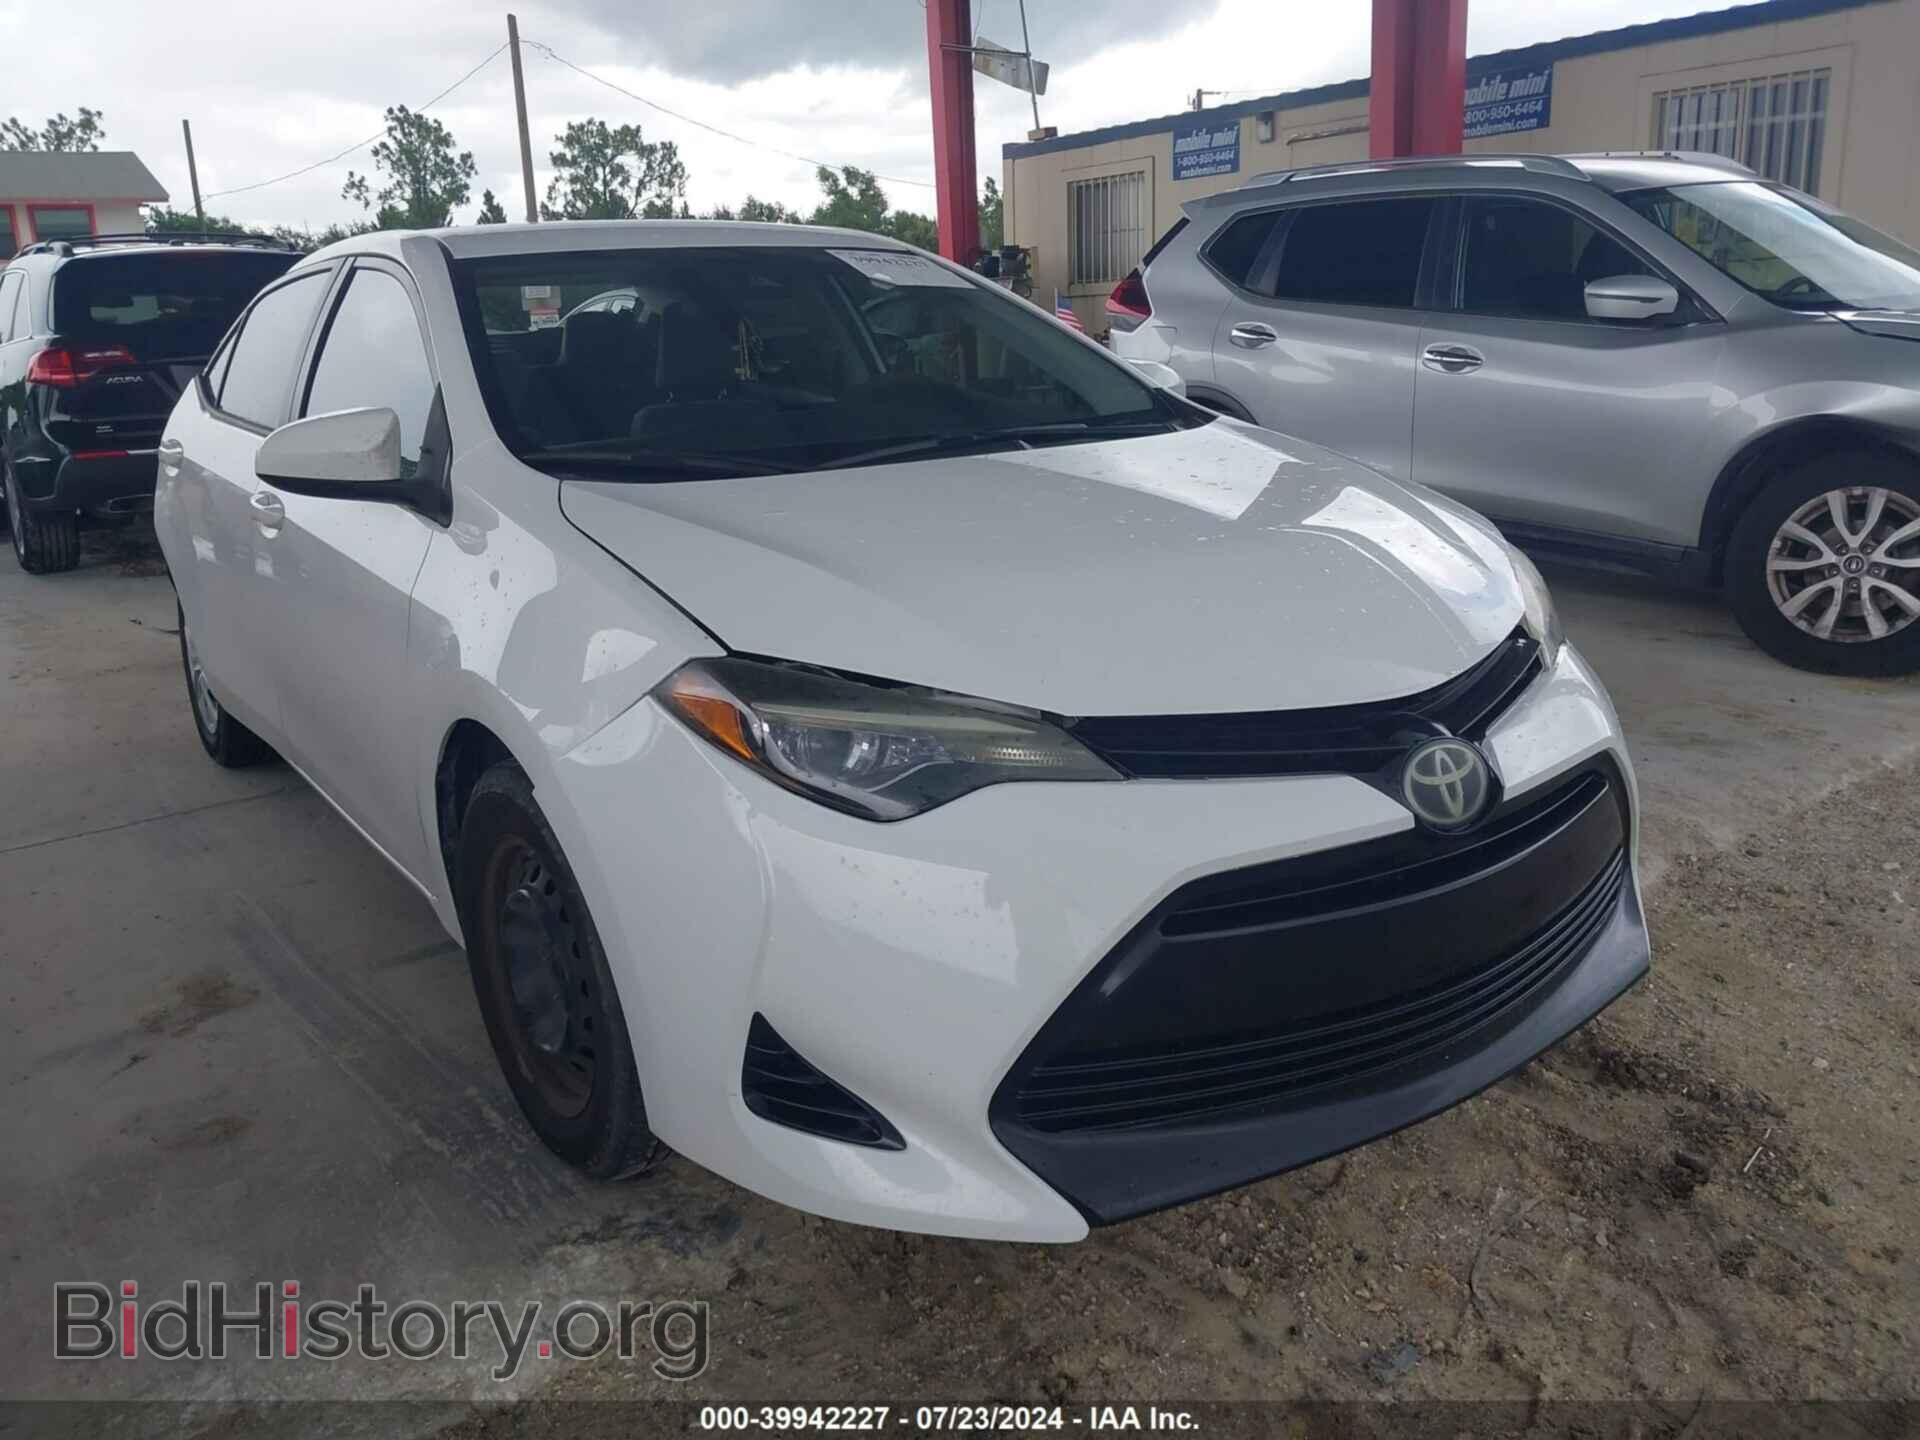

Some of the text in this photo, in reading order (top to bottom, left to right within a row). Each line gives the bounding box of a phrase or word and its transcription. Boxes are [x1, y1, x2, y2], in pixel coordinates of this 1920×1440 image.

[1508, 69, 1549, 98] mini
[1464, 100, 1543, 124] 800-950-6464
[1175, 126, 1238, 152] mobile mini
[106, 375, 144, 384] ACURA
